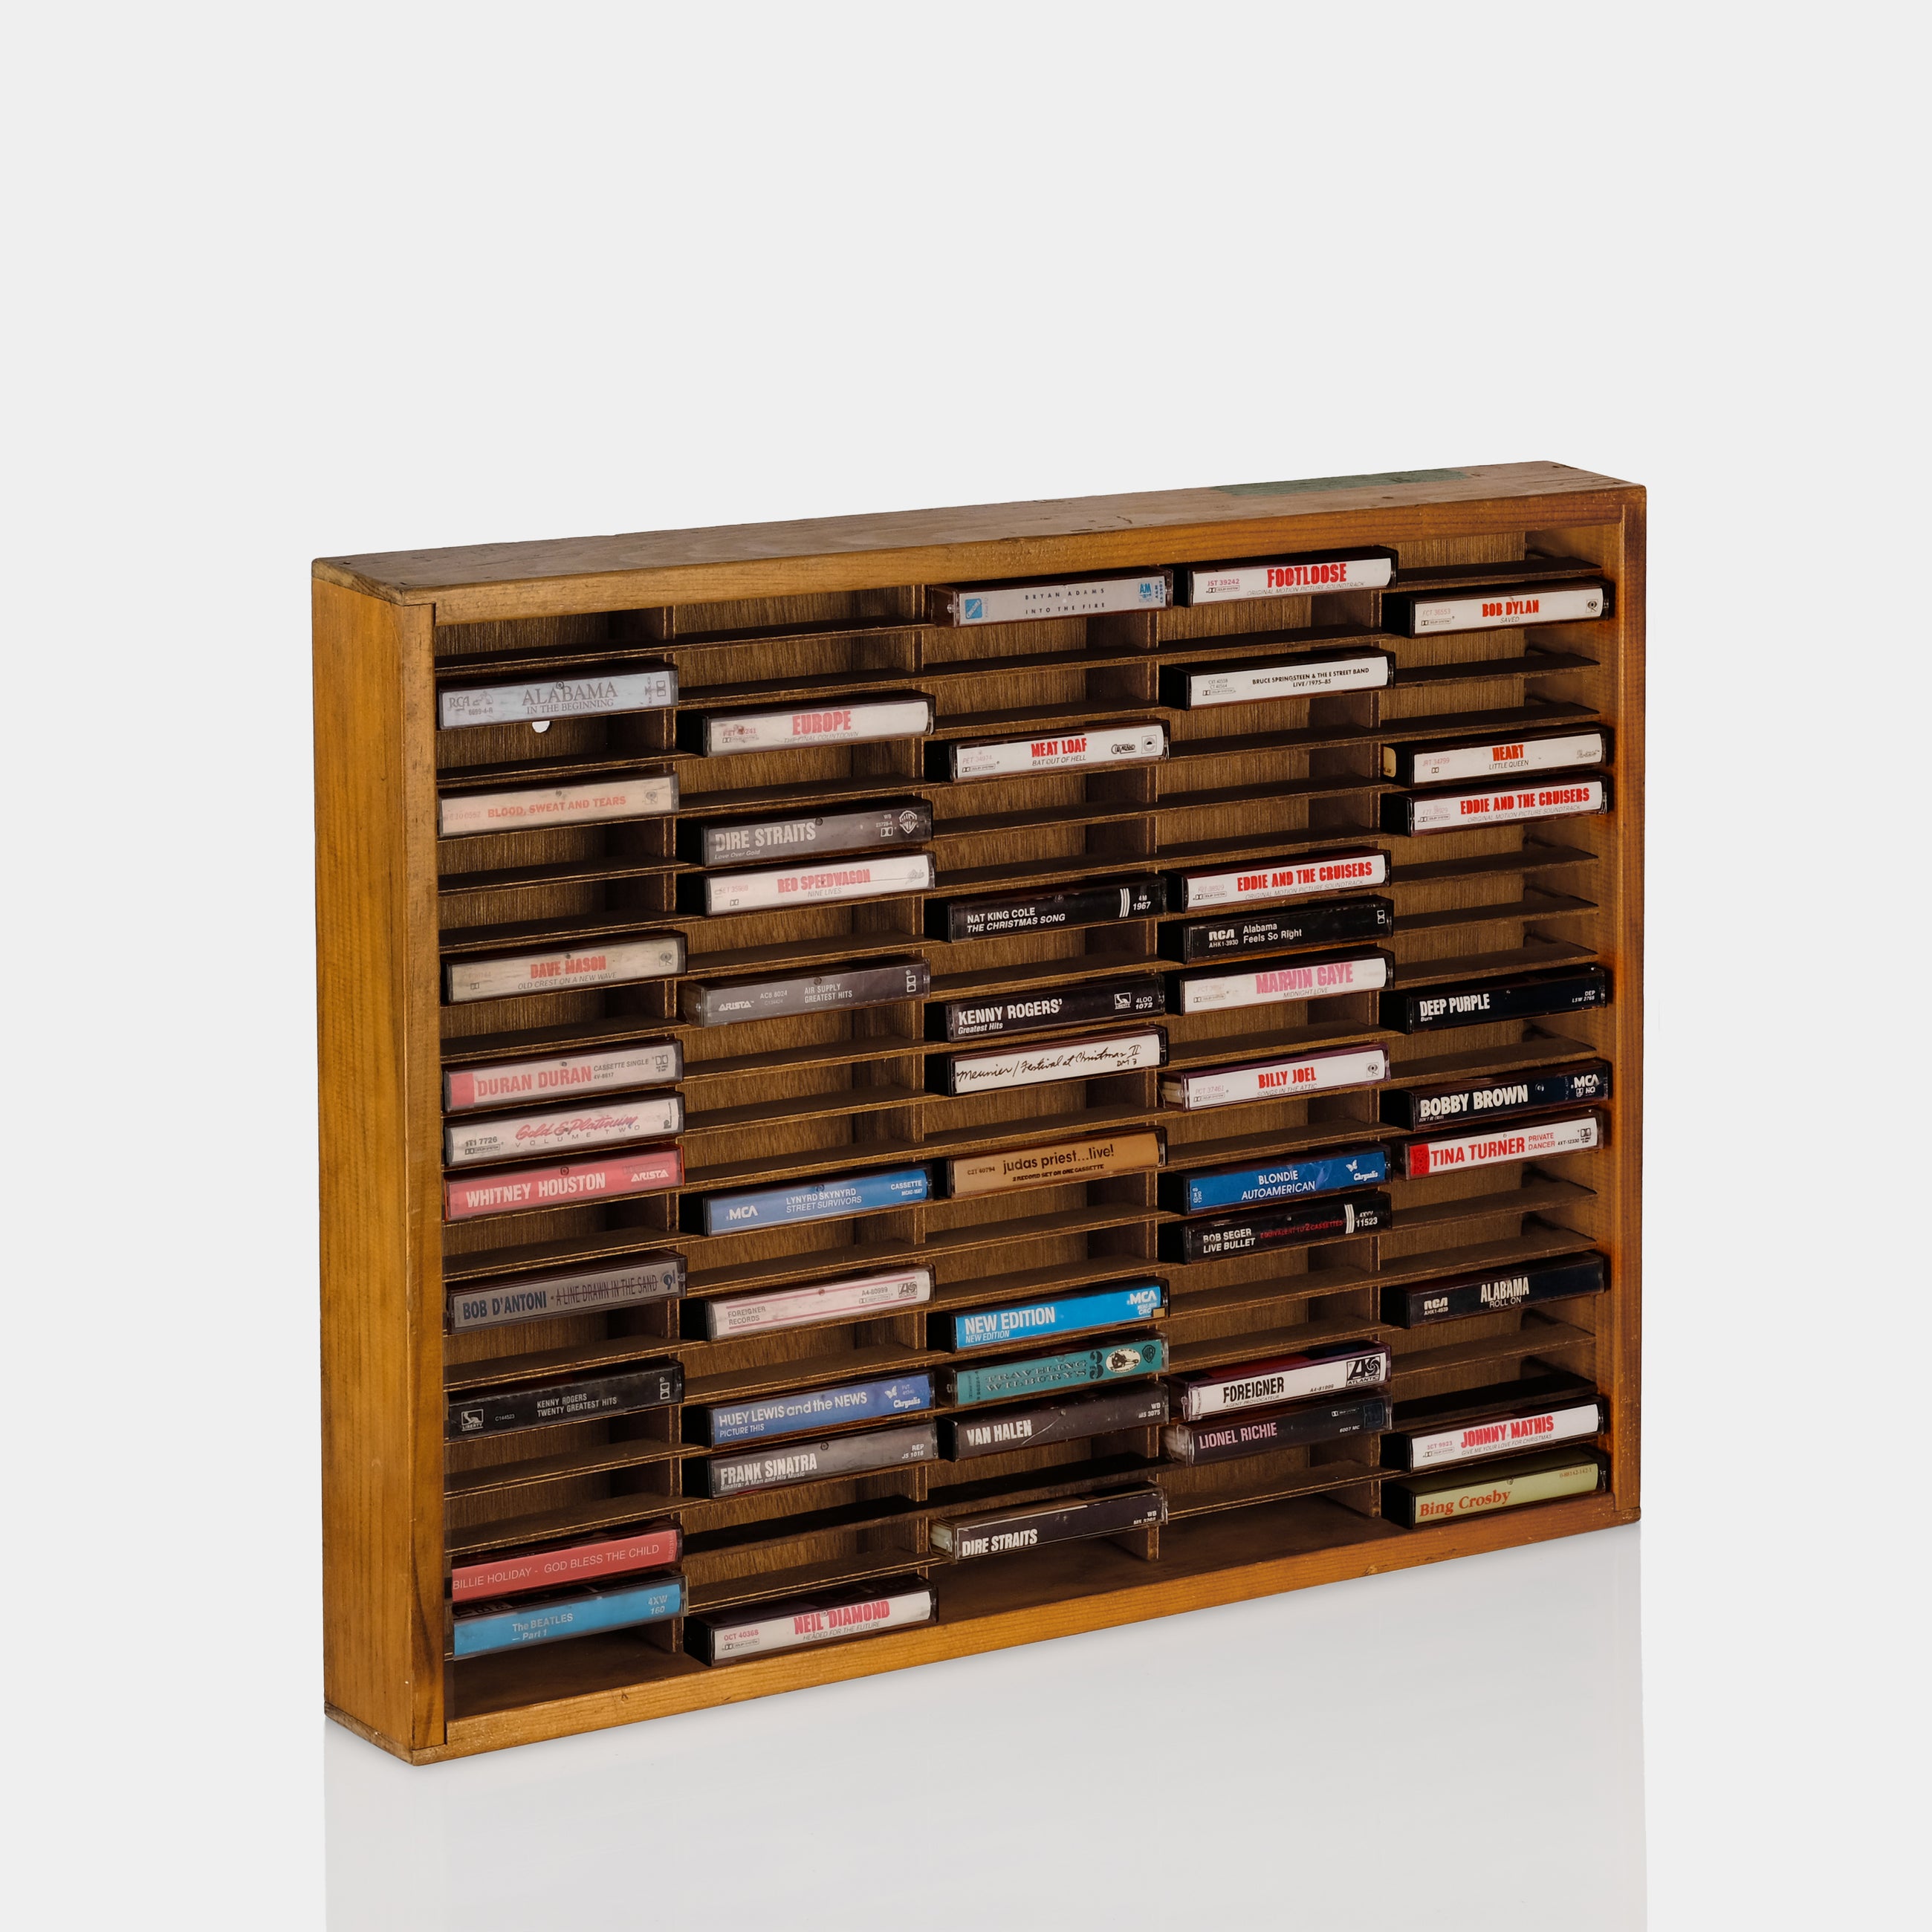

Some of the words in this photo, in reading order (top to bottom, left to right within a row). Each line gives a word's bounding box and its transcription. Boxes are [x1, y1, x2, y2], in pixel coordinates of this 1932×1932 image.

[1267, 563, 1346, 588] FOOTLOOSE
[1482, 603, 1503, 617] BOB
[1505, 599, 1539, 615] DYLAN
[1500, 616, 1520, 624] SAVED
[1252, 677, 1271, 685] BRUCE
[1271, 673, 1310, 684] SPRINGSTEEN
[1332, 670, 1352, 678] STREET
[1352, 667, 1369, 675] BAND
[522, 681, 618, 706] ALABAMA
[527, 706, 537, 714] IN
[539, 703, 560, 713] THE
[562, 698, 615, 712] BEGINNING
[792, 710, 852, 736] EUROPE
[1031, 742, 1058, 757] MEAT
[1061, 738, 1086, 753] LOAF
[1492, 744, 1524, 762] HEART
[1031, 757, 1045, 766] BAT
[1046, 756, 1060, 765] OUT
[1061, 756, 1069, 764] OF
[1070, 754, 1086, 762] HELL
[1489, 762, 1508, 770] LITTLE
[1508, 759, 1529, 768] QUEEN
[487, 806, 526, 819] BLOOD,
[529, 802, 566, 814] SWEAT
[568, 800, 589, 811] AND
[593, 796, 626, 808] TEARS
[1460, 797, 1490, 815] EDDIE
[1493, 795, 1514, 810] AND
[1517, 793, 1535, 808] THE
[1538, 787, 1589, 805] CRUISERS
[715, 830, 749, 852] DIRE
[755, 822, 816, 847] STRAITS
[1237, 873, 1268, 892] EDDIE
[1271, 870, 1294, 886] AND
[1297, 868, 1316, 883] THE
[1319, 861, 1372, 881] CRUISERS
[808, 889, 823, 898] NINE
[824, 887, 843, 896] LIVES
[967, 913, 985, 924] NAT
[987, 910, 1009, 921] KING
[1011, 907, 1035, 918] COLE
[1132, 901, 1152, 910] 1967
[967, 924, 985, 933] THE
[986, 916, 1038, 931] CHRISTMAS
[1040, 913, 1066, 924] SONG
[1242, 923, 1277, 935] Alabama
[1243, 934, 1265, 944] Feels
[1268, 932, 1279, 941] So
[1281, 929, 1303, 941] Right
[531, 963, 562, 979] DAVE
[565, 956, 606, 974] MASON
[804, 986, 816, 994] AIR
[817, 983, 841, 993] SUPPLY
[1255, 969, 1313, 994] MARVIN
[1317, 963, 1353, 986] GAYE
[805, 992, 837, 1003] GREATEST
[837, 990, 853, 999] HITS
[1419, 999, 1447, 1017] DEEP
[1448, 993, 1491, 1014] PURPLE
[958, 1005, 1002, 1025] KENNY
[1007, 998, 1063, 1020] ROGERS'
[958, 1023, 987, 1035] Greatest
[988, 1022, 1003, 1031] Hits
[594, 1062, 625, 1072] CASSETTE
[626, 1059, 649, 1068] SINGLE
[1021, 1057, 1062, 1075] Festival
[1063, 1056, 1071, 1067] at
[1075, 1046, 1127, 1063] Christmas
[477, 1074, 533, 1097] DURAN
[538, 1066, 592, 1088] DURAN
[1258, 1071, 1288, 1089] BILLY
[1292, 1067, 1317, 1083] JOEL
[1421, 1094, 1469, 1118] BOBBY
[1473, 1084, 1529, 1110] BROWN
[1528, 1141, 1555, 1150] DANCER
[1529, 1132, 1555, 1141] PRIVATE
[1430, 1147, 1465, 1166] TINA
[1468, 1137, 1526, 1161] TURNER
[631, 1169, 670, 1182] ARISTA
[890, 1180, 923, 1190] CASSETTE
[1258, 1170, 1299, 1185] BLONDIE
[467, 1182, 532, 1208] WHITNEY
[538, 1173, 606, 1197] HOUSTON
[786, 1192, 817, 1205] LYNYRD
[819, 1187, 857, 1202] SKYNYRD
[1241, 1181, 1315, 1202] AUTOAMERICAN
[726, 1205, 758, 1221] MCA
[786, 1202, 817, 1213] STREET
[817, 1196, 862, 1210] SURVIVORS
[1202, 1232, 1221, 1243] BOB
[1222, 1228, 1252, 1239] SEGER
[1203, 1242, 1222, 1254] LIVE
[1223, 1237, 1256, 1250] BULLET
[1480, 1276, 1529, 1303] ALABAMA
[727, 1306, 766, 1317] FOREIGNER
[1489, 1299, 1508, 1309] ROLL
[1510, 1296, 1522, 1306] ON
[728, 1315, 760, 1325] RECORDS
[965, 1315, 997, 1335] NEW
[1001, 1306, 1055, 1330] EDITION
[965, 1335, 982, 1343] NEW
[982, 1330, 1010, 1341] EDITION
[985, 1359, 1087, 1381] TRAVELING
[986, 1368, 1086, 1392] WILBURYS
[1348, 1375, 1379, 1385] ATLANTIC
[1223, 1376, 1284, 1404] FOREIGNER
[537, 1398, 559, 1409] KENNY
[562, 1393, 587, 1404] ROGERS
[537, 1405, 565, 1419] TWENTY
[567, 1400, 600, 1413] GREATEST
[602, 1397, 617, 1407] HITS
[719, 1410, 749, 1427] HUEY
[752, 1407, 785, 1422] LEWIS
[787, 1401, 811, 1416] and
[812, 1398, 832, 1413] the
[834, 1392, 868, 1407] NEWS
[719, 1426, 748, 1437] PICTURE
[750, 1423, 765, 1432] THIS
[967, 1428, 991, 1446] VAN
[993, 1419, 1032, 1441] HALEN
[1199, 1429, 1239, 1449] LIONEL
[1241, 1422, 1278, 1442] RICHIE
[1461, 1424, 1507, 1449] JOHNNY
[1510, 1415, 1554, 1439] MATHIS
[720, 1462, 761, 1485] FRANK
[765, 1453, 817, 1477] SINATRA
[1419, 1498, 1454, 1517] Bing
[1459, 1488, 1511, 1509] Crosby
[962, 1537, 989, 1557] DIRE
[991, 1529, 1038, 1552] STRAITS
[453, 1575, 484, 1590] BILLIE
[487, 1567, 531, 1584] HOLIDAY
[544, 1560, 568, 1573] GOD
[570, 1554, 603, 1569] BLESS
[605, 1549, 626, 1562] THE
[629, 1544, 660, 1558] CHILD
[512, 1622, 529, 1633] The
[531, 1613, 573, 1628] BEATLES
[794, 1613, 824, 1634] NEIL
[826, 1601, 890, 1628] DIAMOND
[803, 1630, 828, 1641] HEADED
[829, 1627, 842, 1636] FOR
[843, 1626, 855, 1634] THE
[856, 1621, 880, 1632] FUTURE
